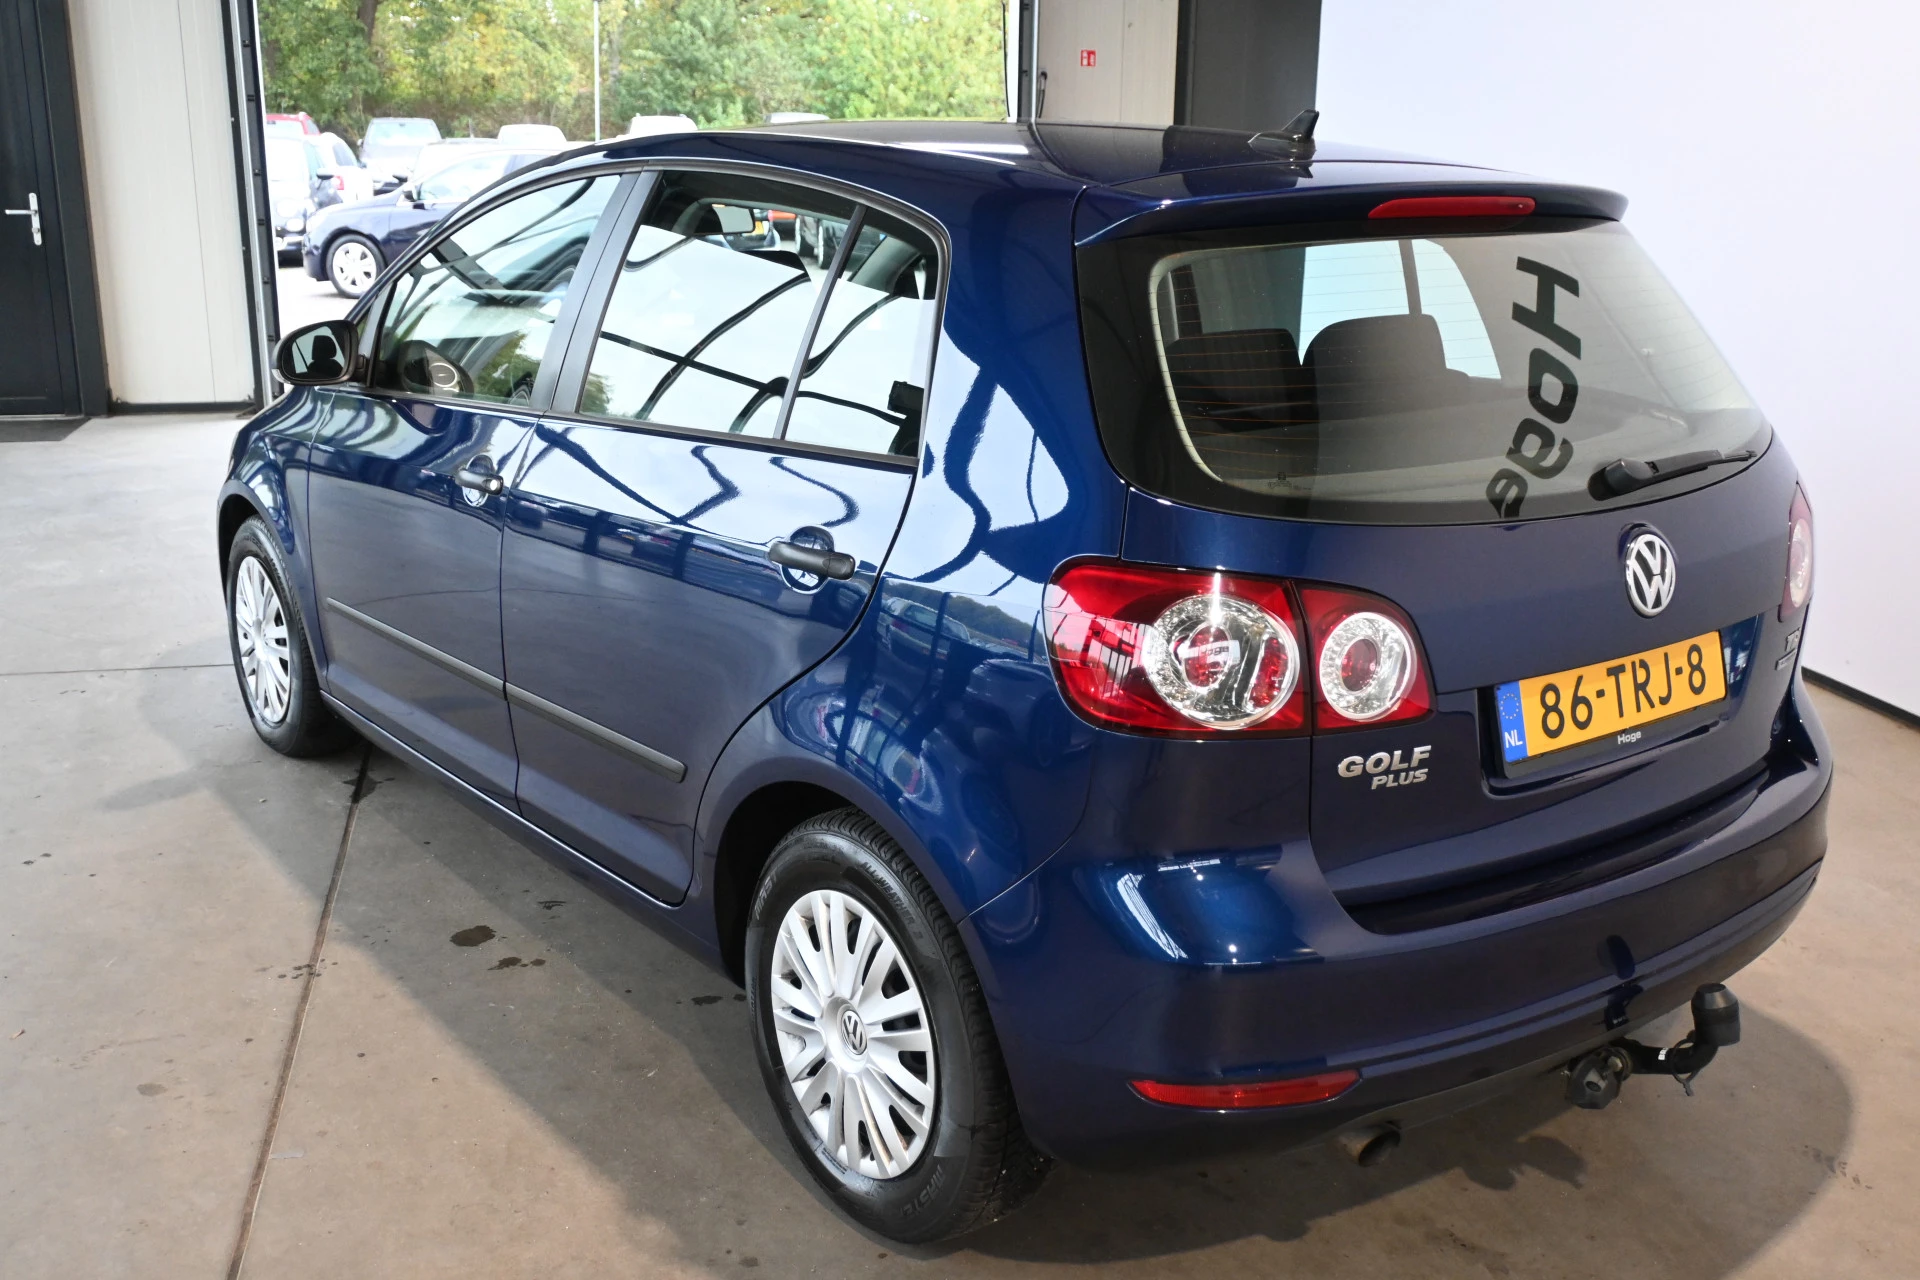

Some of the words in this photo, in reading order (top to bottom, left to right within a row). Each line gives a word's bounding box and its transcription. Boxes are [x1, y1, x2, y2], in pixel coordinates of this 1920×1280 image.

[1540, 644, 1706, 739] 86-TRJ-8
[1504, 729, 1523, 748] NL
[1617, 731, 1642, 745] Hoge
[1338, 745, 1431, 778] GOLF
[1371, 768, 1429, 790] PLUS
